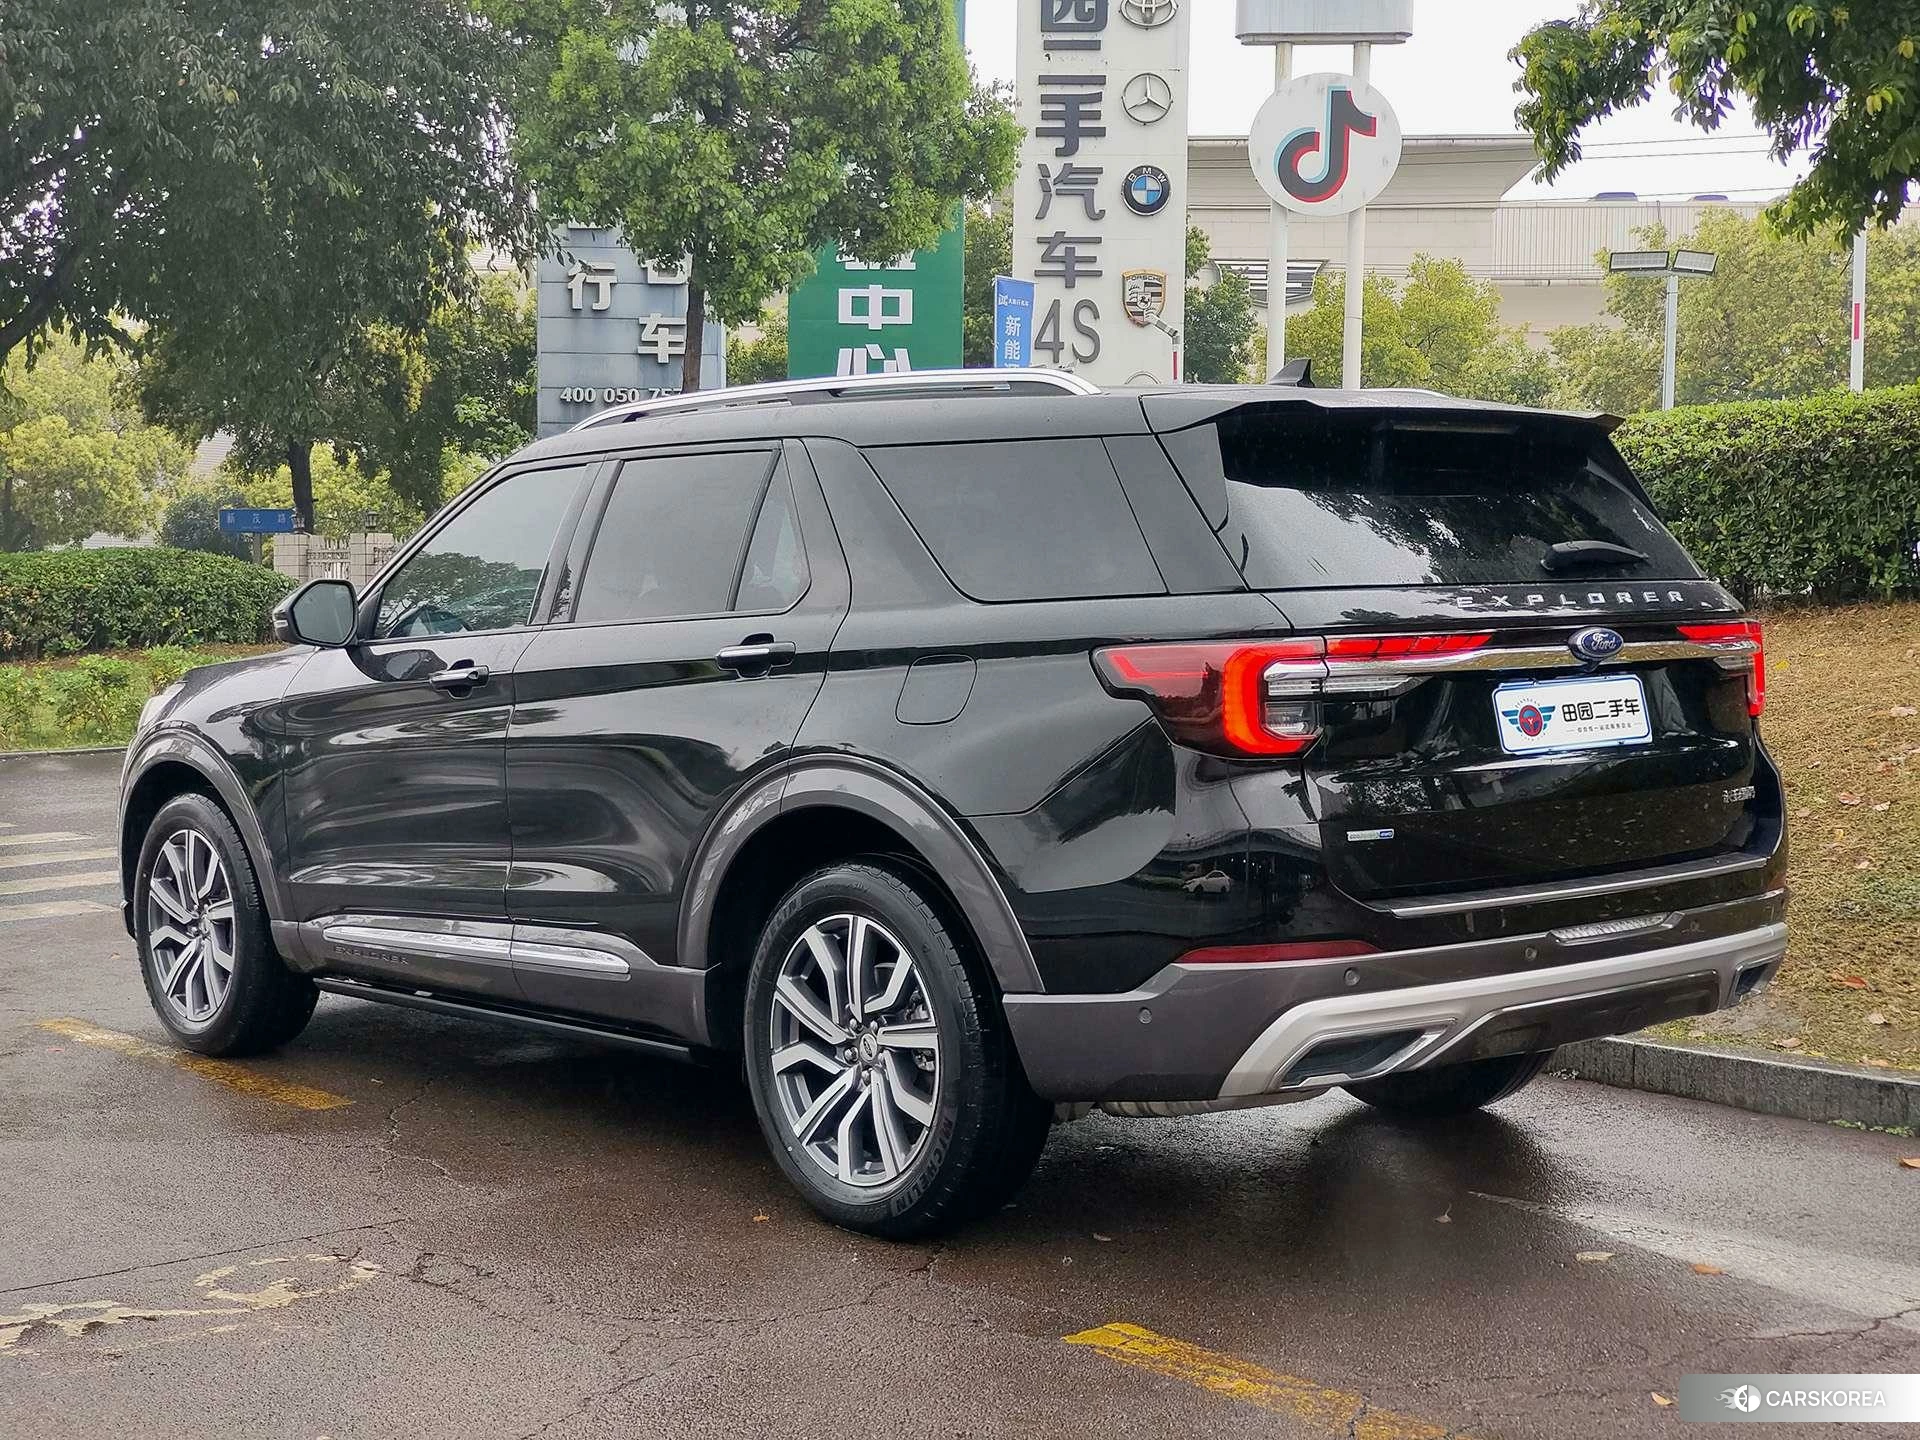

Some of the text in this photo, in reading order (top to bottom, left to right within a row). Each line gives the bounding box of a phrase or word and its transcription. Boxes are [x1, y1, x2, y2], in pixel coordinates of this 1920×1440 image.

[1128, 167, 1167, 183] BMW
[1004, 314, 1022, 368] 新能
[1034, 299, 1101, 364] 4S
[560, 387, 597, 403] 400
[603, 388, 641, 403] 050
[1456, 591, 1685, 608] EXPLORER
[1590, 631, 1618, 651] Ford
[1561, 697, 1641, 723] 田园二手车
